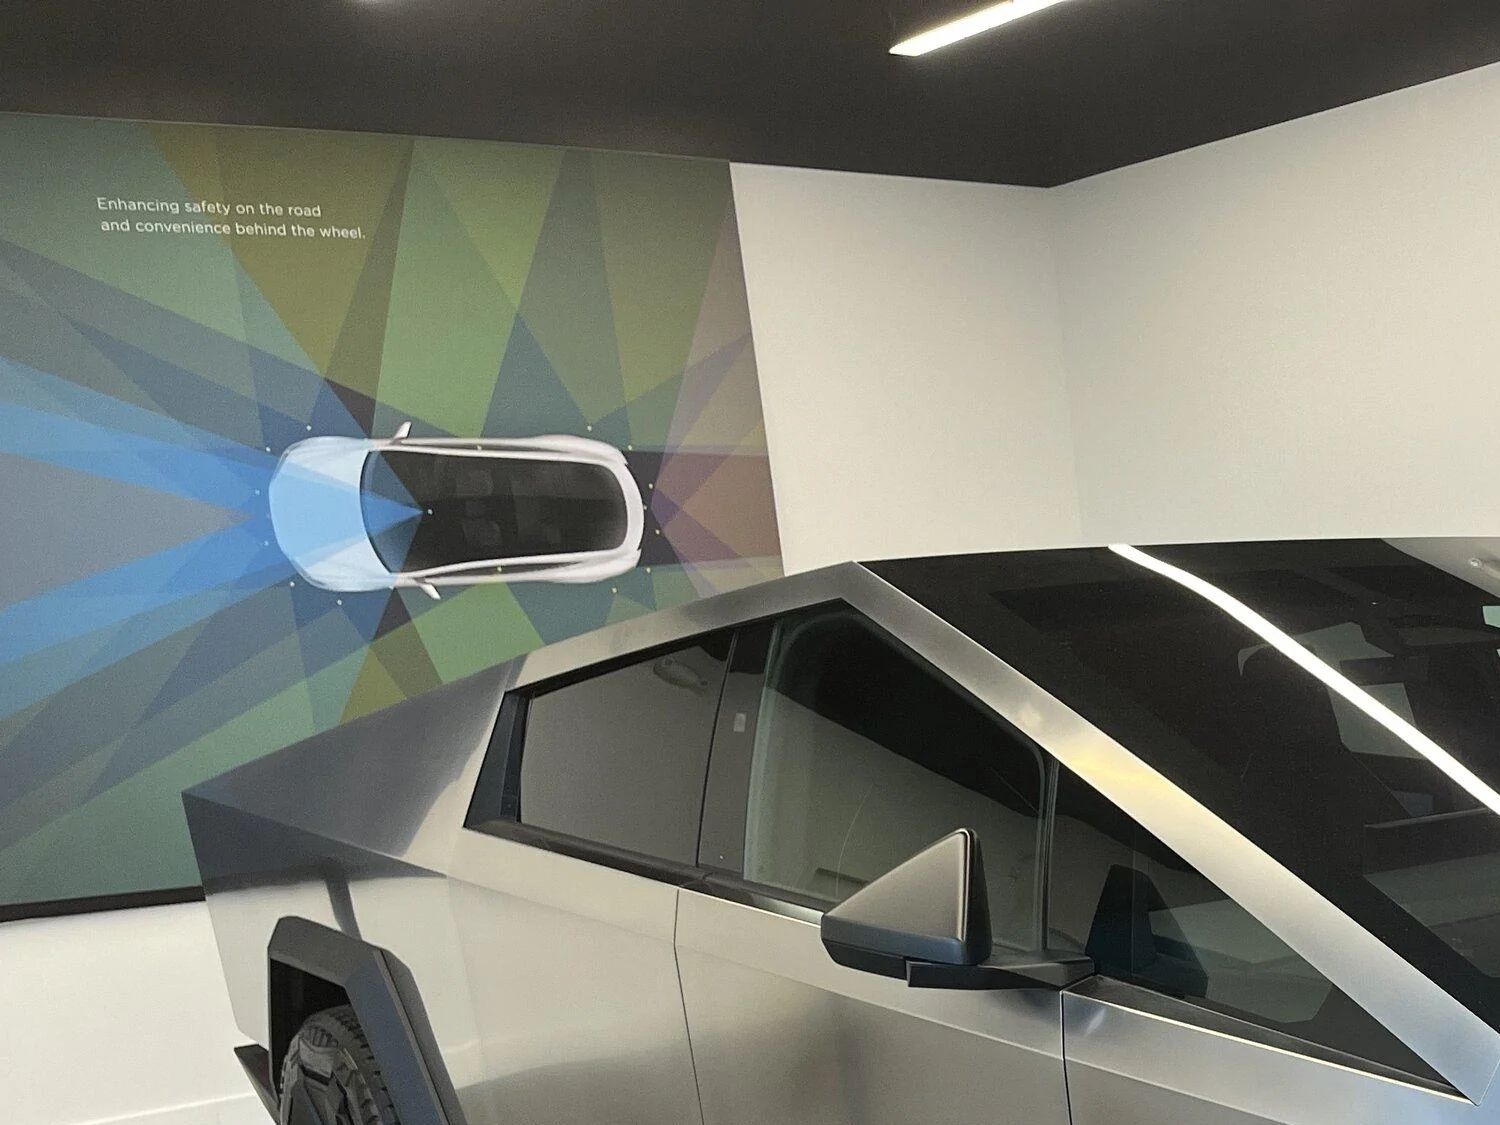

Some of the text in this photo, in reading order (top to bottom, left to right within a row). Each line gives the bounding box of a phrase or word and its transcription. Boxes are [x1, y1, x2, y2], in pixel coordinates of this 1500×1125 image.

[97, 197, 322, 218] Enhancing safety on the road
[100, 219, 366, 240] and convenience behind the wheel.
